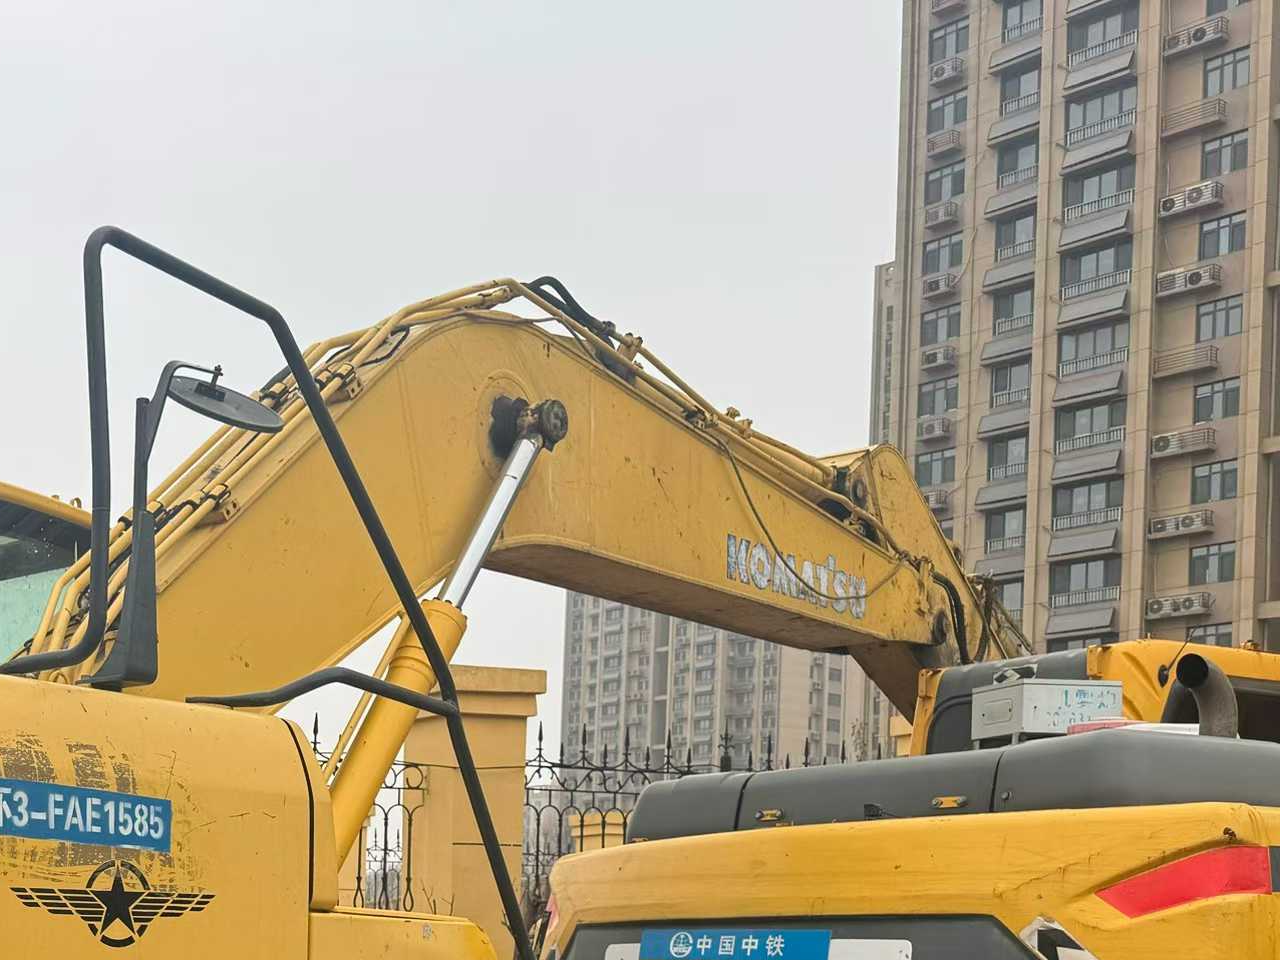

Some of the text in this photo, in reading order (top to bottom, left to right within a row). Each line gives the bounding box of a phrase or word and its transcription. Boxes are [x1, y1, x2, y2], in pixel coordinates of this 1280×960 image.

[727, 533, 866, 619] KOMATSU
[696, 934, 785, 957] 中国中铁
